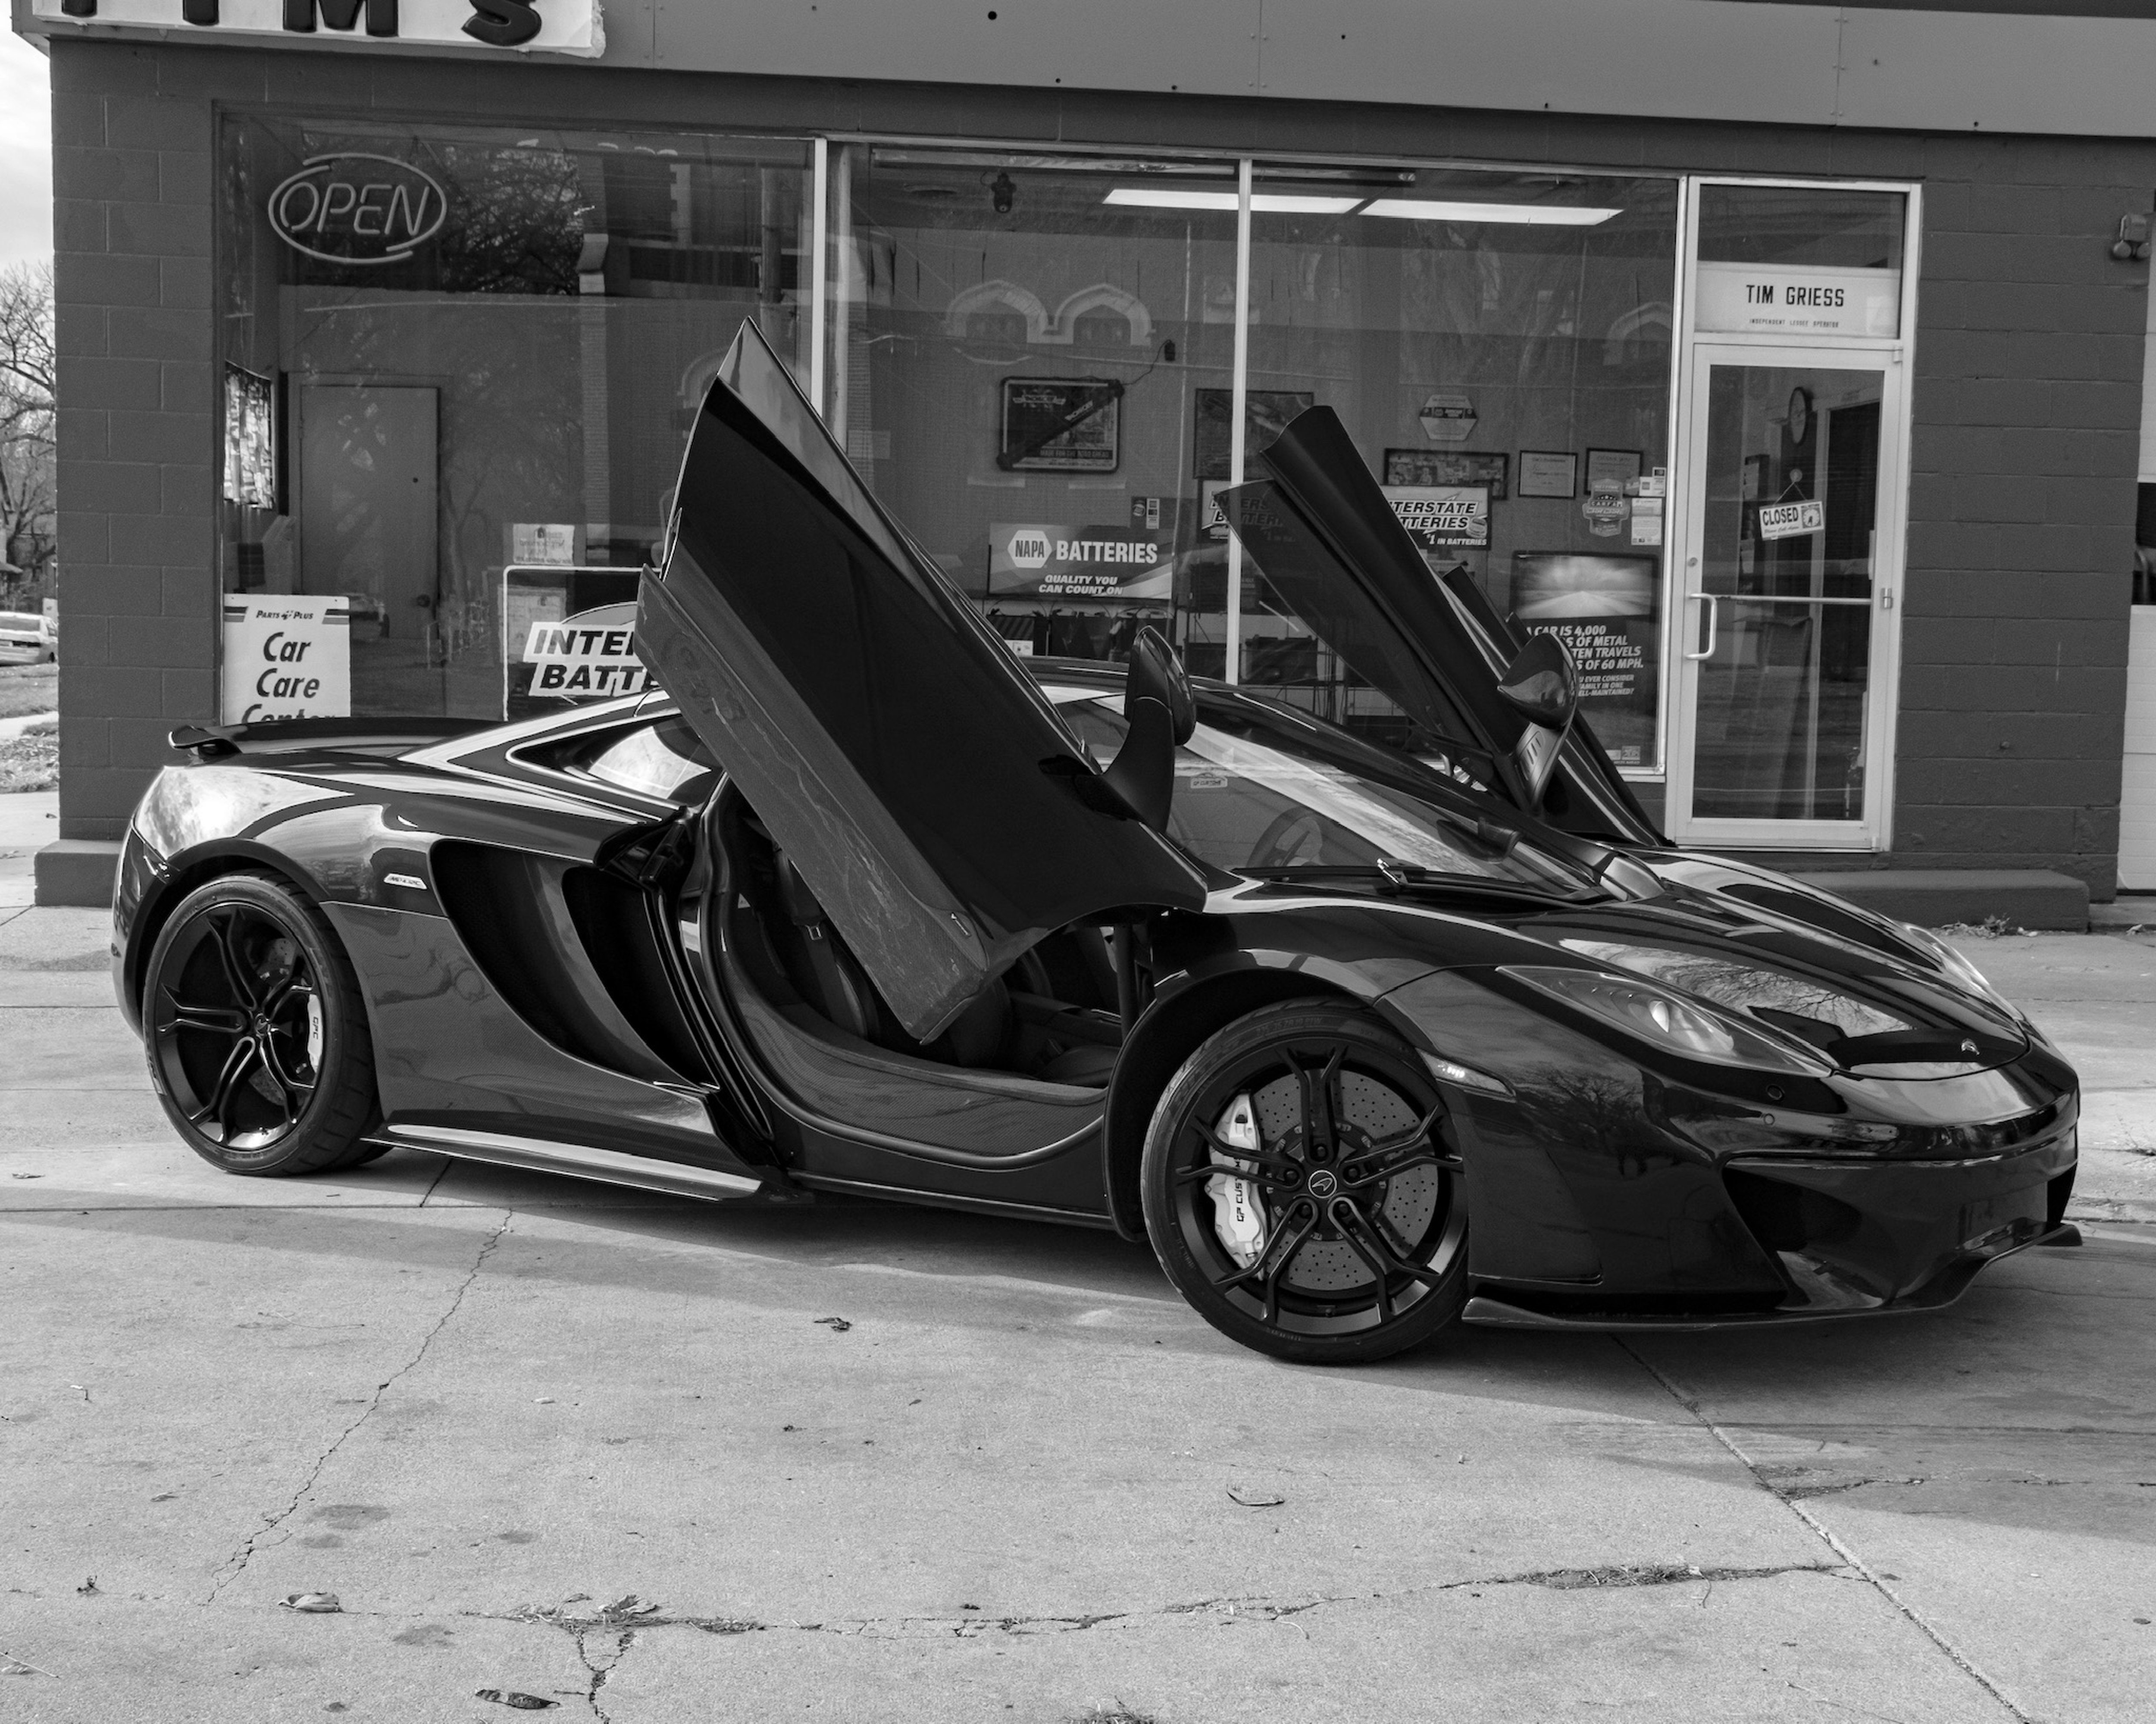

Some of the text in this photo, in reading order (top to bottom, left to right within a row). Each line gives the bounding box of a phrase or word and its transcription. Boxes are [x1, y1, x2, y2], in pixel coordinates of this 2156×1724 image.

[280, 182, 430, 236] OPEN
[1746, 285, 1844, 306] TIM GRIESS
[1763, 507, 1799, 526] CLOSED
[1015, 540, 1158, 564] NAPA BATTERIES
[1045, 574, 1118, 585] QUALITY YOU
[1039, 584, 1123, 595] CAN COUNT ON
[293, 611, 314, 619] PLUS
[1535, 626, 1558, 636] CAR
[1560, 626, 1572, 636] IS
[1574, 625, 1606, 637] 4,000
[263, 632, 311, 662] Car
[1576, 637, 1593, 647] OF
[1594, 635, 1627, 646] METAL
[1596, 646, 1642, 657] TRAVELS
[1585, 660, 1600, 670] OF
[1602, 659, 1615, 670] 60
[1617, 659, 1643, 669] MPH.
[256, 668, 320, 698] Care
[1236, 1207, 1245, 1222] GP
